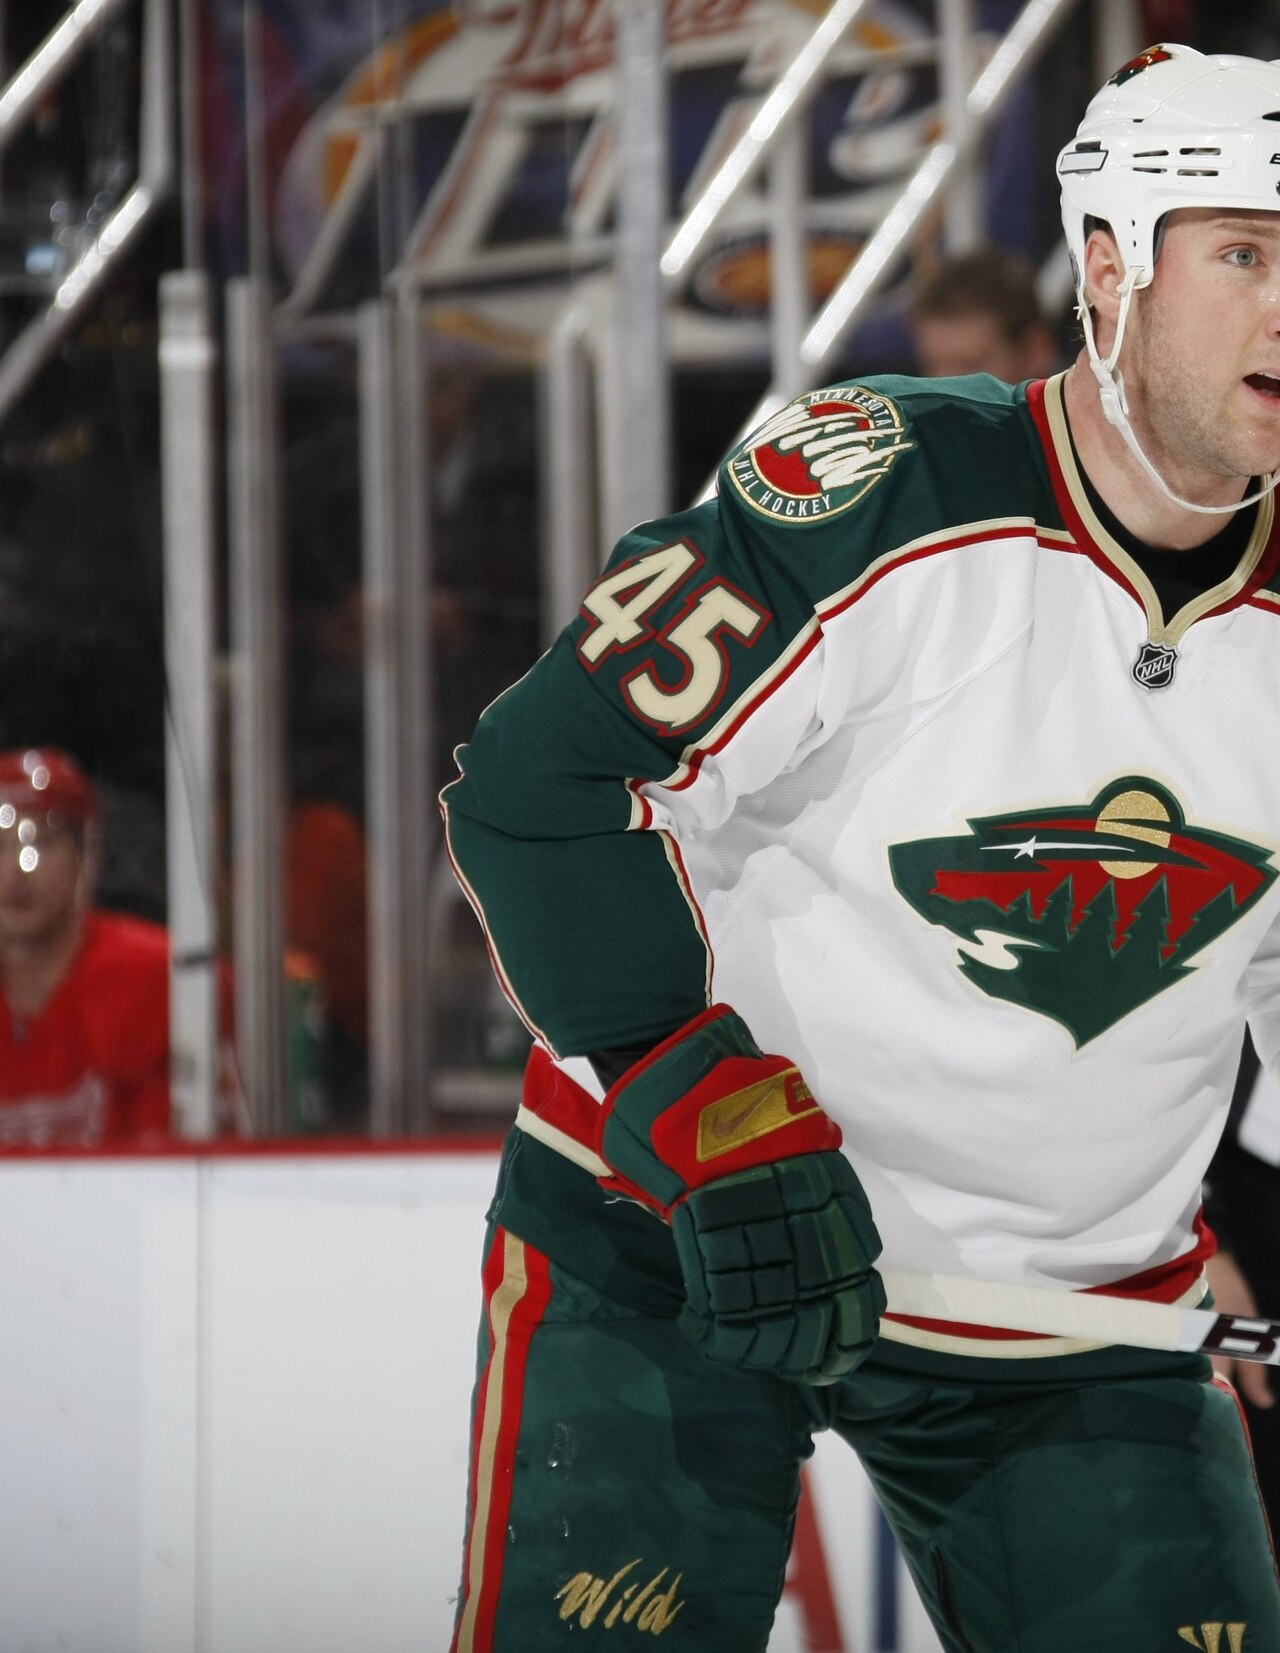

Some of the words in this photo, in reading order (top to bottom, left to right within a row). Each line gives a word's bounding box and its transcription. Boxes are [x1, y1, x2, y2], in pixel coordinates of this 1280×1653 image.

[810, 388, 893, 427] MINNESOTA
[743, 403, 914, 491] Wild
[733, 460, 758, 493] NHL
[758, 493, 832, 517] HOCKEY
[576, 535, 774, 738] 45
[1140, 656, 1171, 679] NHL
[553, 1557, 686, 1637] Wild
